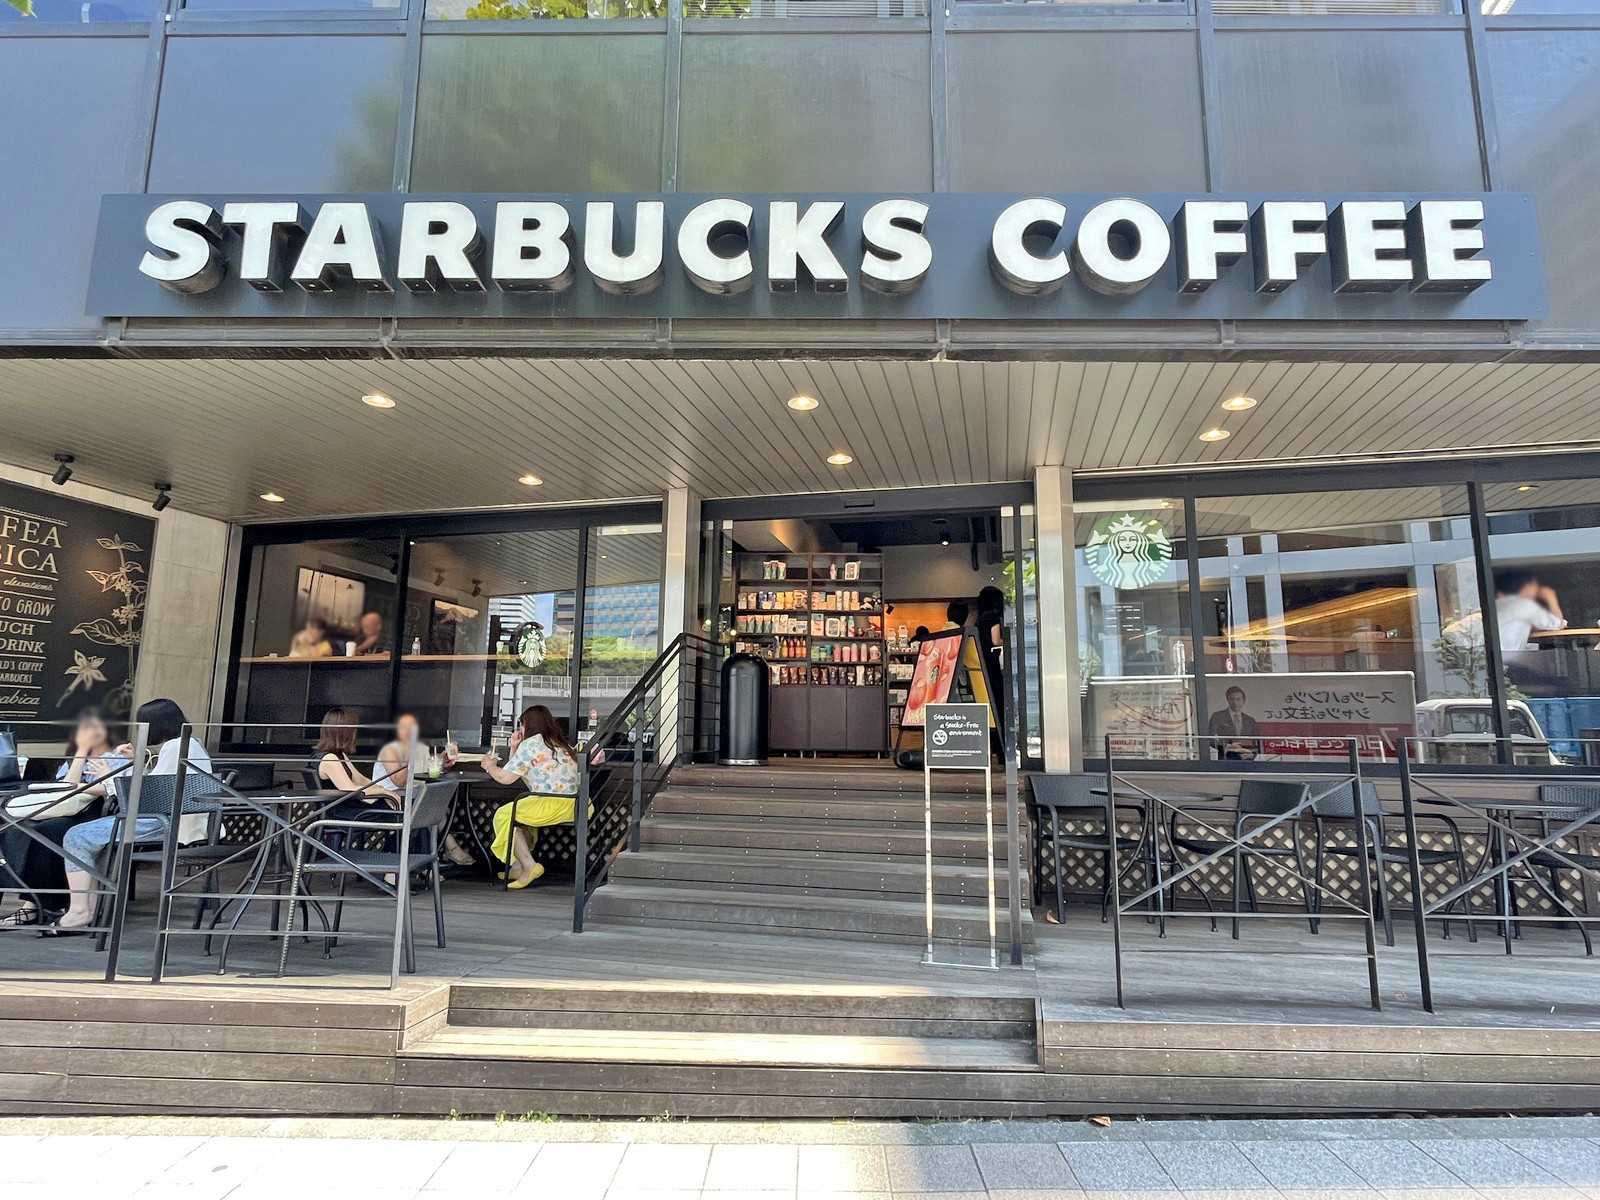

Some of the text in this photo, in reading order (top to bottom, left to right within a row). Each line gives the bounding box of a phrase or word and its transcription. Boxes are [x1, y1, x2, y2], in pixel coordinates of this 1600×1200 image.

[138, 197, 1492, 285] STARBUCKS COFFEE
[16, 598, 55, 617] GROW
[18, 661, 44, 673] COFFEE
